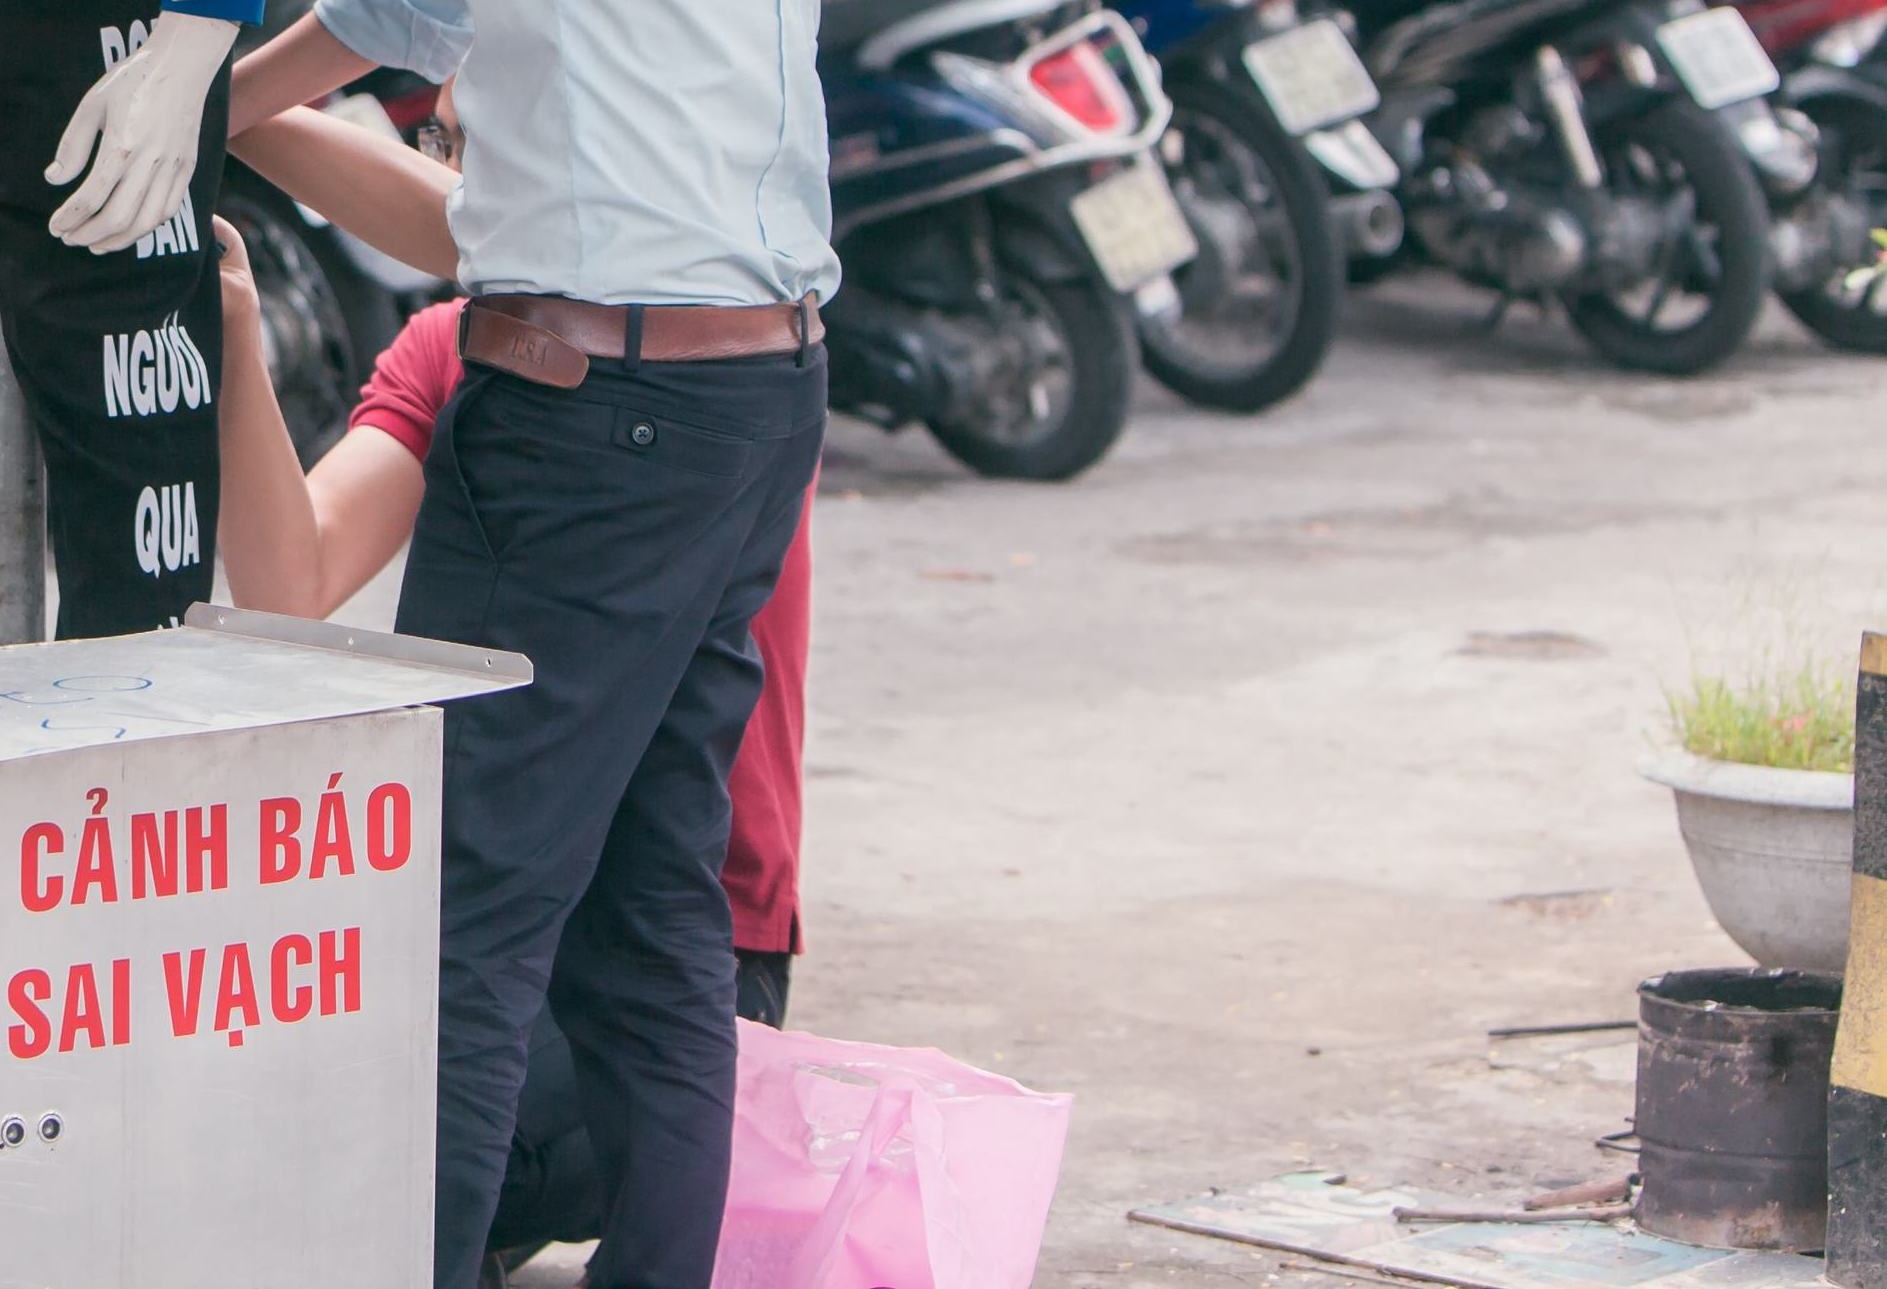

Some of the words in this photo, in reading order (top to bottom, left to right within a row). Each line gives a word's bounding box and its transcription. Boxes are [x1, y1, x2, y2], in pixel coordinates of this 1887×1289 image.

[134, 481, 200, 579] QUA
[21, 790, 228, 913] CẢNH
[260, 774, 411, 884] BÁO
[8, 960, 130, 1059] SAI
[162, 928, 361, 1047] VẠCH
